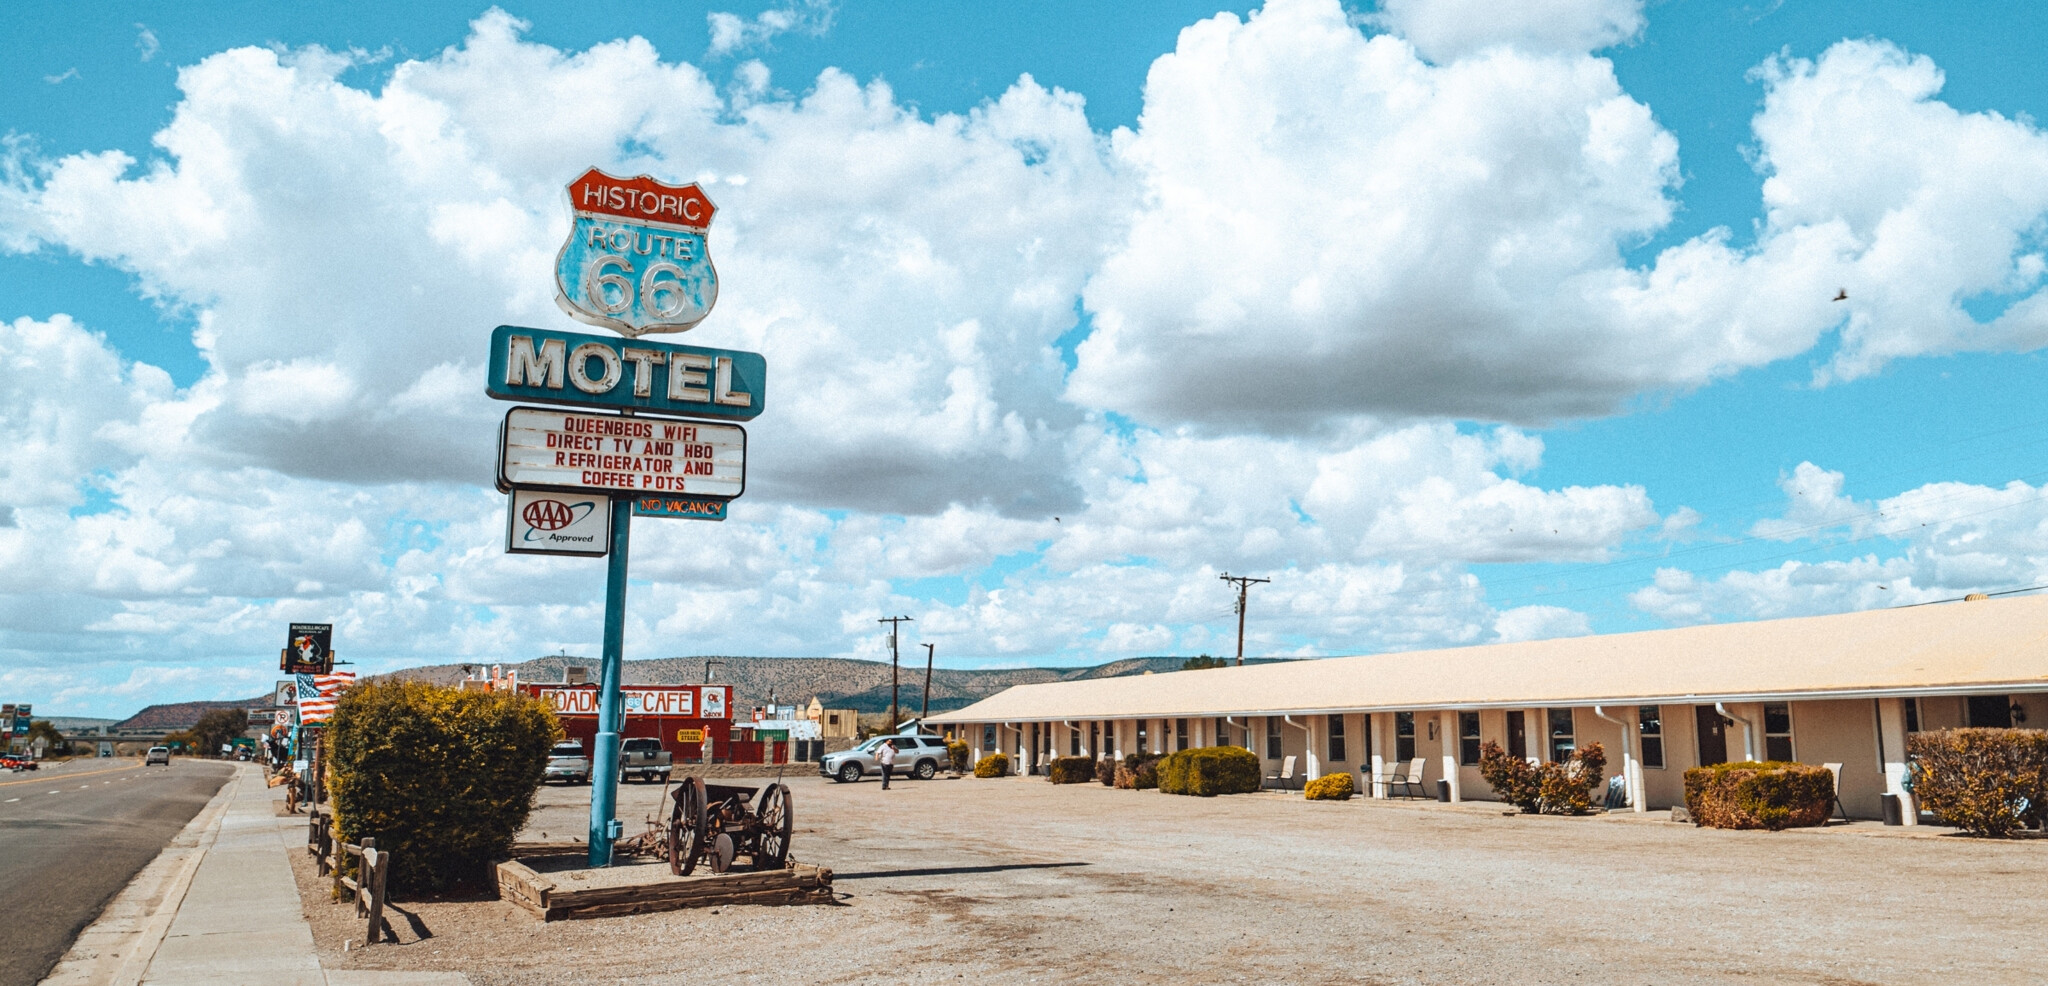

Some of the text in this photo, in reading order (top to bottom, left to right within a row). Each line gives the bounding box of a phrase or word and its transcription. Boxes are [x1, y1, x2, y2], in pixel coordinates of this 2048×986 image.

[584, 183, 701, 220] HISTORIC
[588, 226, 692, 260] ROUTE
[587, 255, 688, 317] 66
[505, 334, 751, 407] MOTEL
[564, 417, 697, 441] QUEENBEDS WIFI
[546, 433, 713, 459] DIRECT TV AND HBO
[555, 451, 713, 475] REFRIGERATOR AND
[582, 471, 684, 490] COFFEE POTS
[526, 500, 571, 530] AAA
[641, 499, 723, 515] NO VACANCY
[549, 533, 594, 543] Approved
[643, 692, 691, 712] CAFE
